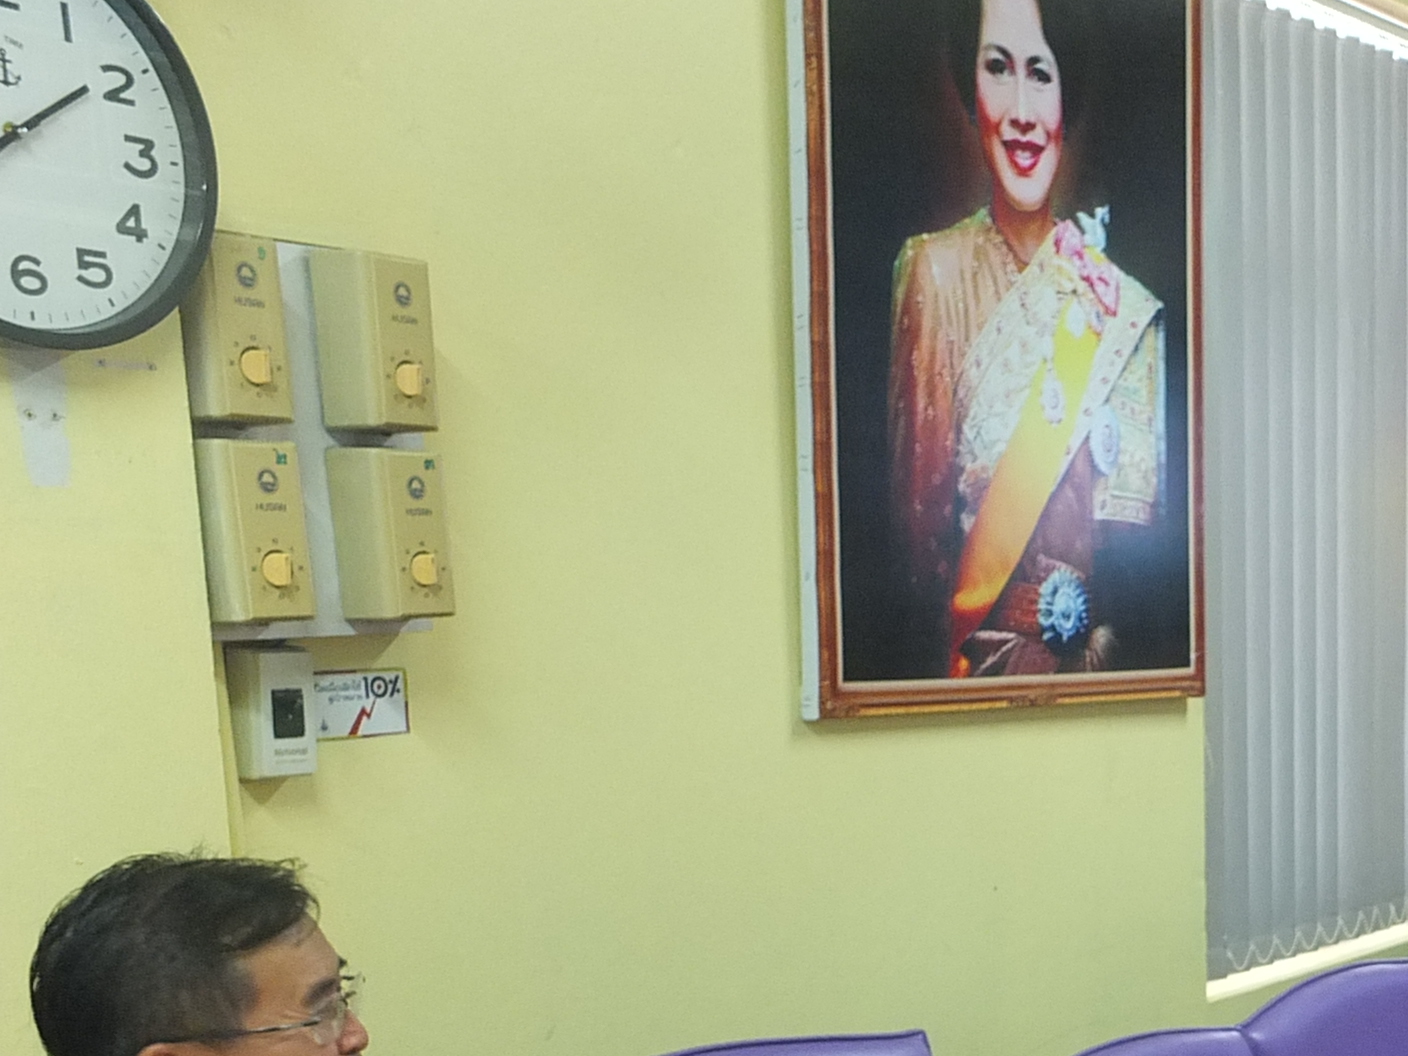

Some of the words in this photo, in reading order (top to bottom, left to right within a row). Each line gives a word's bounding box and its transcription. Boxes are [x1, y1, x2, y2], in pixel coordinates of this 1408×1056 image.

[99, 63, 136, 107] 2
[122, 133, 159, 180] 3
[115, 203, 149, 244] 4
[9, 253, 49, 297] 6
[75, 247, 114, 290] 5
[362, 674, 402, 699] 10%
